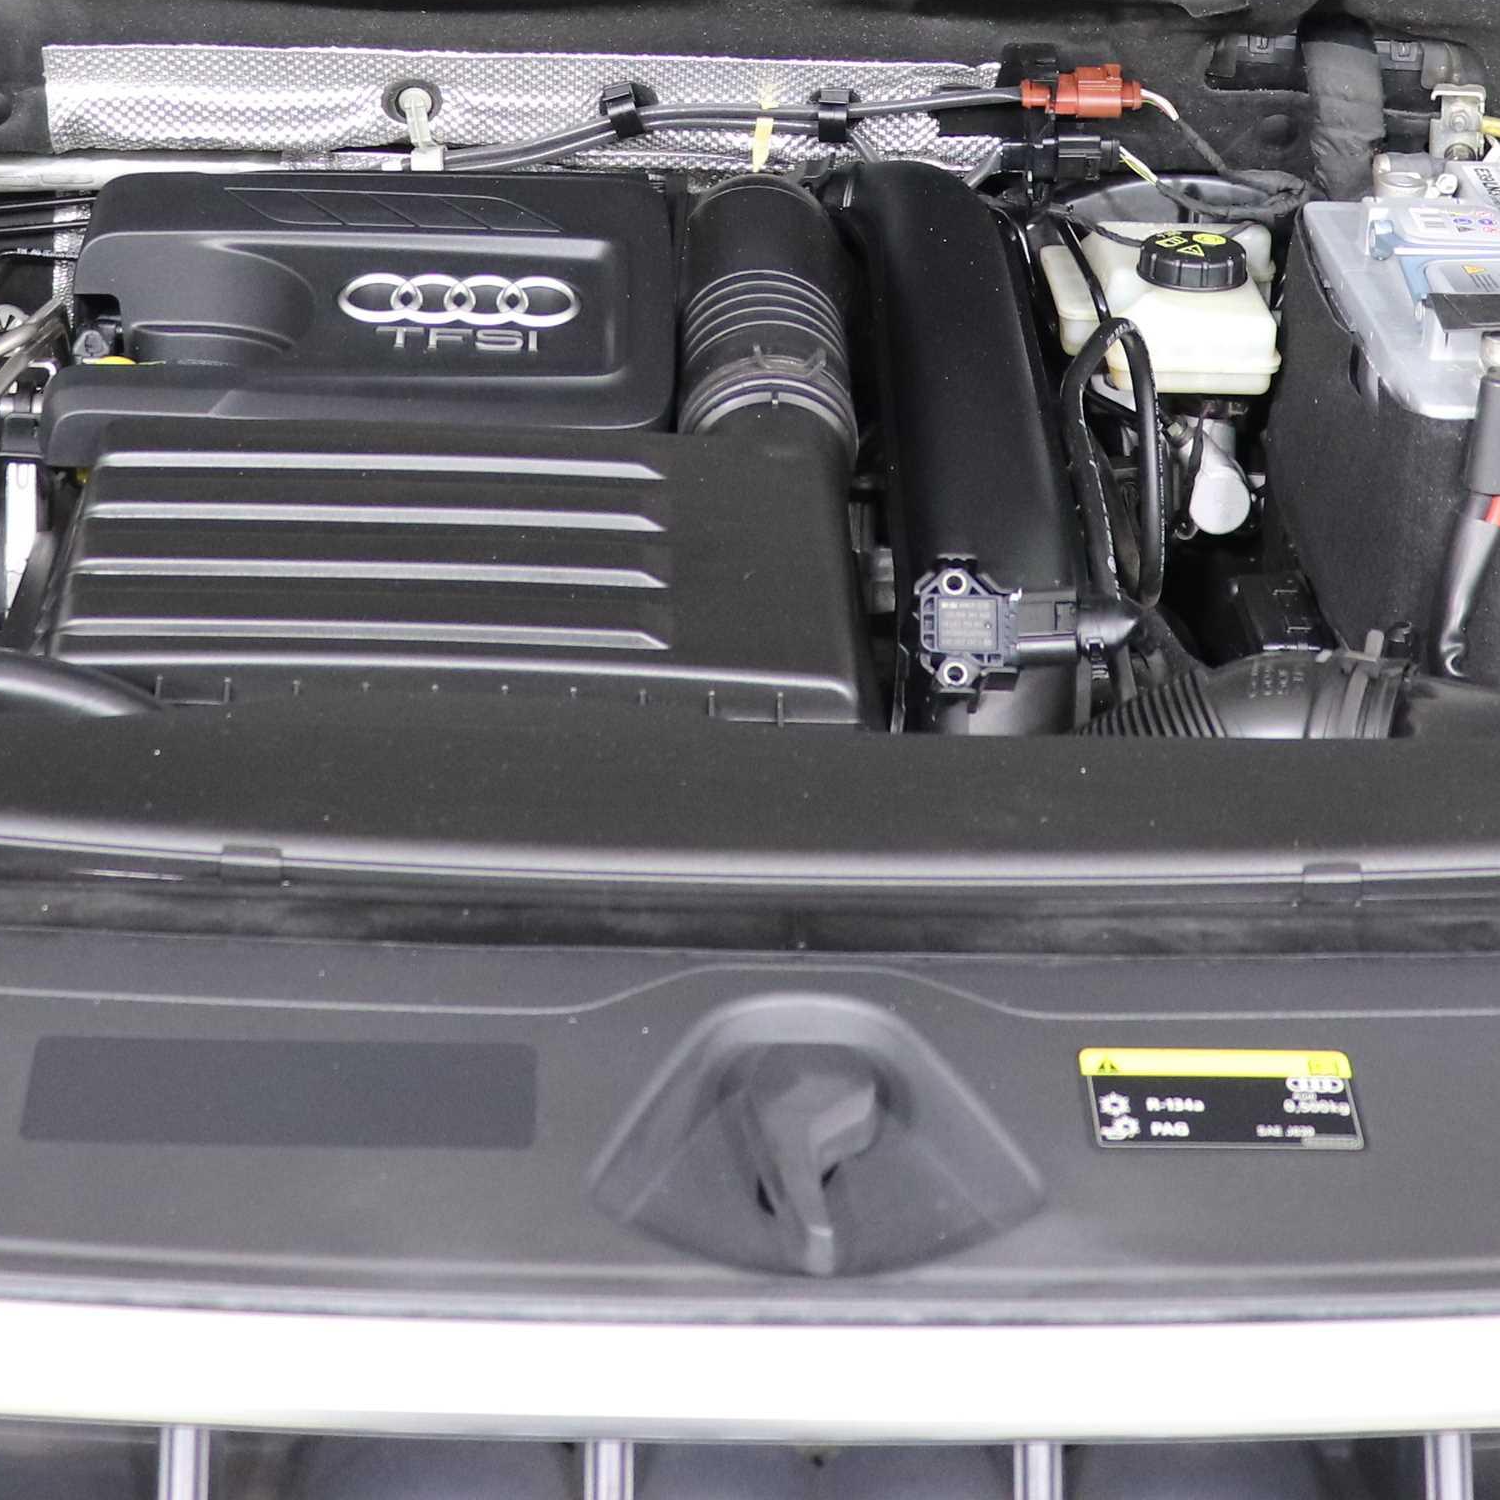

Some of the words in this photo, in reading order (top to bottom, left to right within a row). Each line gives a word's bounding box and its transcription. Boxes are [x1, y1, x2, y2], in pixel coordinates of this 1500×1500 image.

[376, 325, 538, 352] TFSI
[1145, 1096, 1205, 1113] R-134a
[1150, 1120, 1191, 1138] PAG
